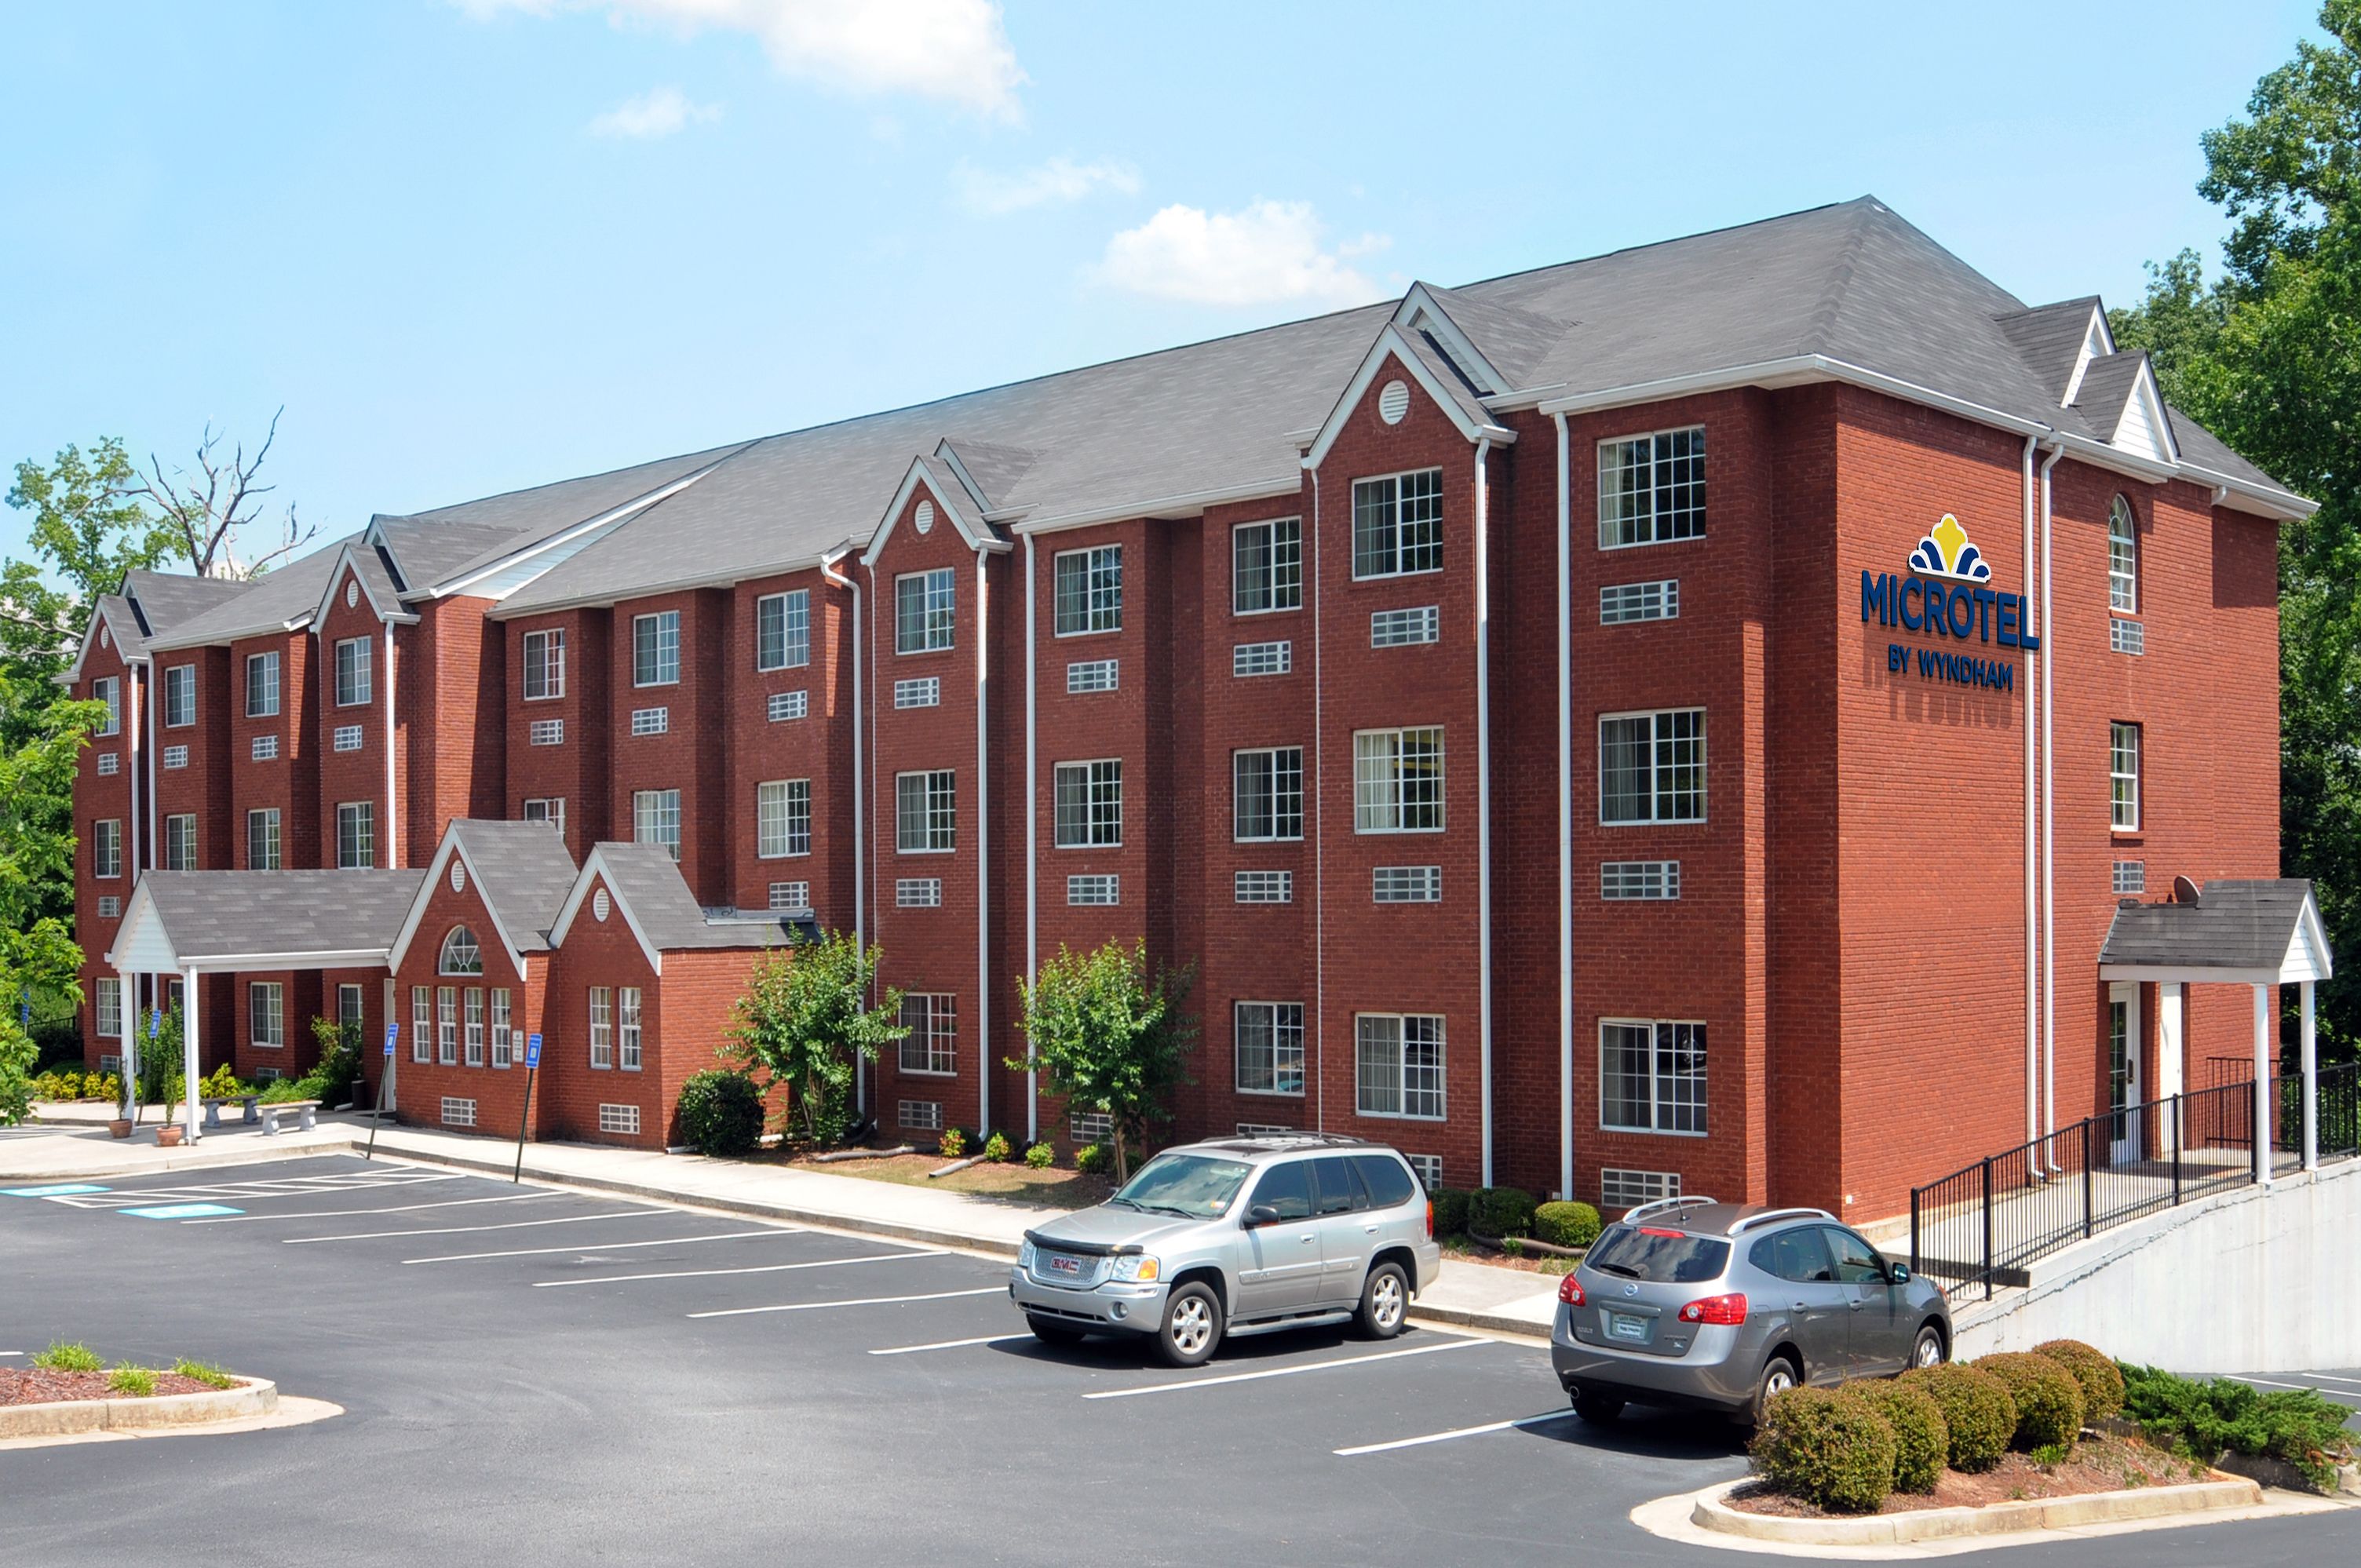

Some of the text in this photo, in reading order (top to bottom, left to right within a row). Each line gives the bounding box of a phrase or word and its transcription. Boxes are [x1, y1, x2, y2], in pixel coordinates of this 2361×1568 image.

[1861, 570, 2039, 651] MICROTEL
[1888, 644, 2013, 691] BY WYNDHAM
[1051, 1257, 1080, 1271] GMC
